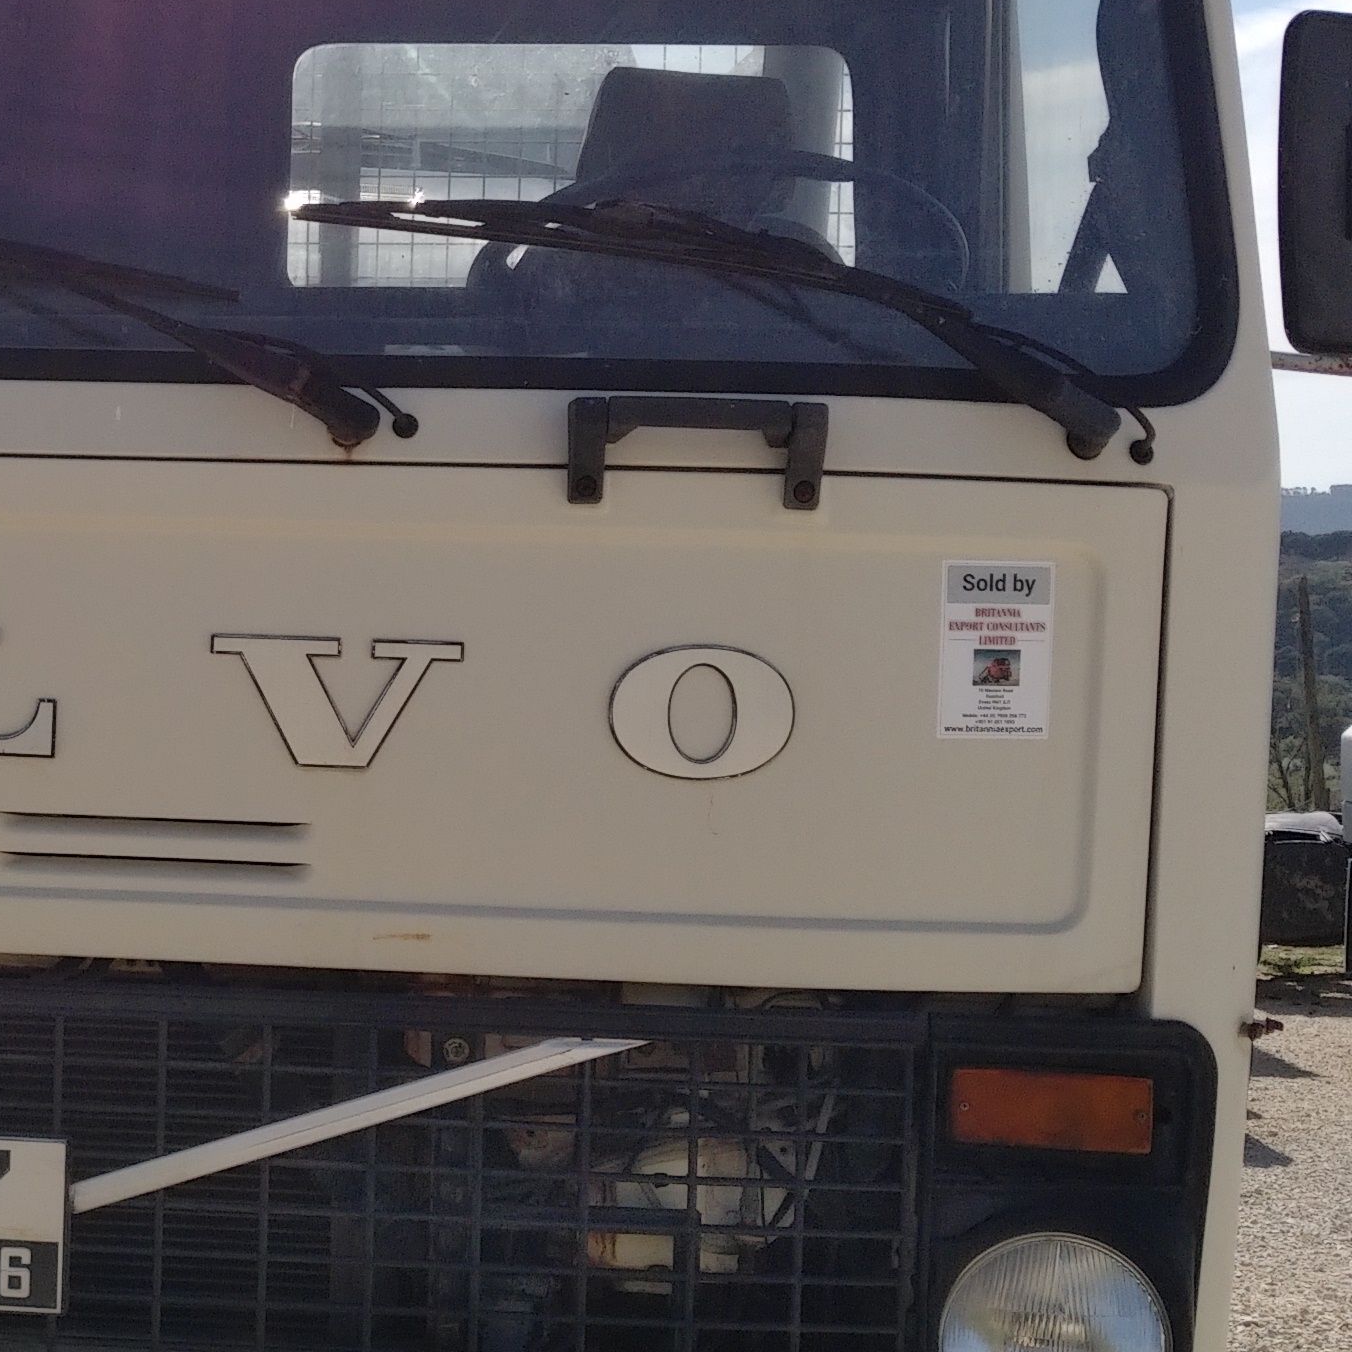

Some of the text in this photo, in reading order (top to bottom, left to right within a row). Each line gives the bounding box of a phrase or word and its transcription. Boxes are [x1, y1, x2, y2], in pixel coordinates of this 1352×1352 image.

[962, 573, 1036, 597] Sold by
[975, 608, 1021, 618] BRITANNIA
[949, 621, 1046, 632] EXPORT CONSULTANTS
[978, 635, 1016, 646] LIMITED
[0, 1246, 32, 1298] 6
